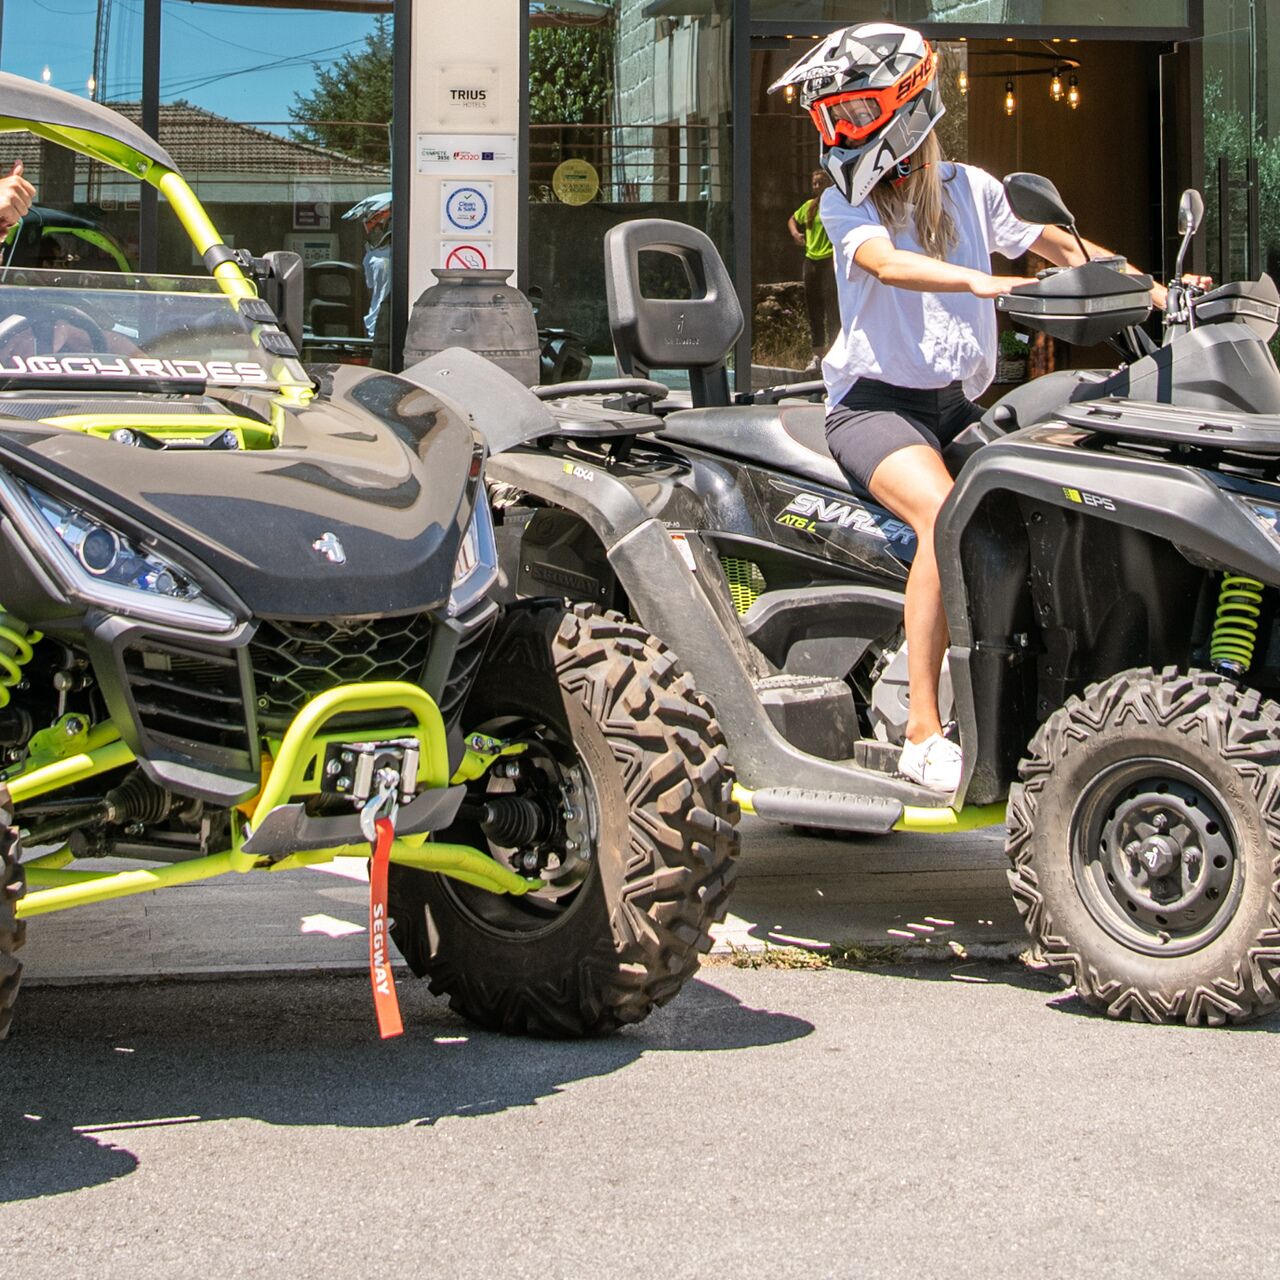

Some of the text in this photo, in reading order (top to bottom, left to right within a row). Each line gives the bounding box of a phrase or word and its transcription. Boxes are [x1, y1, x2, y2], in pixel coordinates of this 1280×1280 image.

[449, 89, 487, 101] TRIUS
[462, 101, 487, 109] HOTELS
[129, 358, 269, 384] RIDES
[1081, 491, 1117, 511] EPS
[778, 514, 805, 528] AT6
[786, 493, 917, 546] SNARLER
[372, 903, 390, 995] SEGWAY
